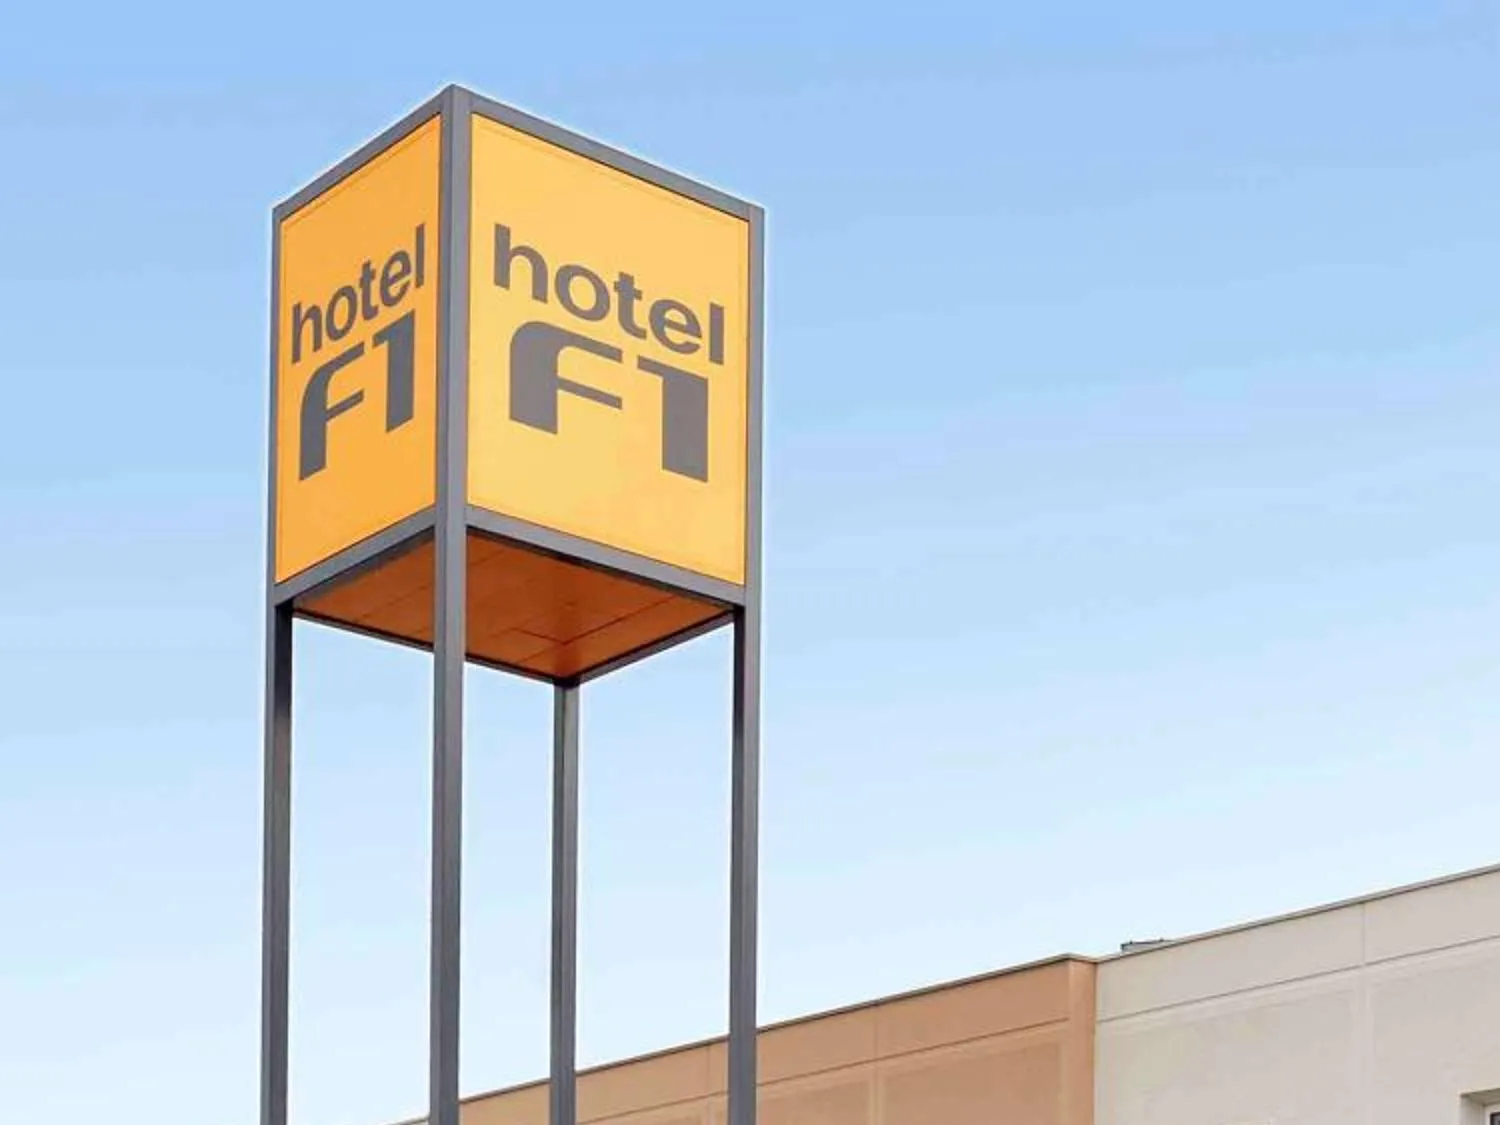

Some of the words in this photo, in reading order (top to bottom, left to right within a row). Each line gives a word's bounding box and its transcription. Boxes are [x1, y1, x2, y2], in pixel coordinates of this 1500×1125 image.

[291, 222, 426, 365] hotel
[493, 223, 724, 365] hotel
[300, 309, 416, 481] F1
[509, 320, 709, 483] F1
